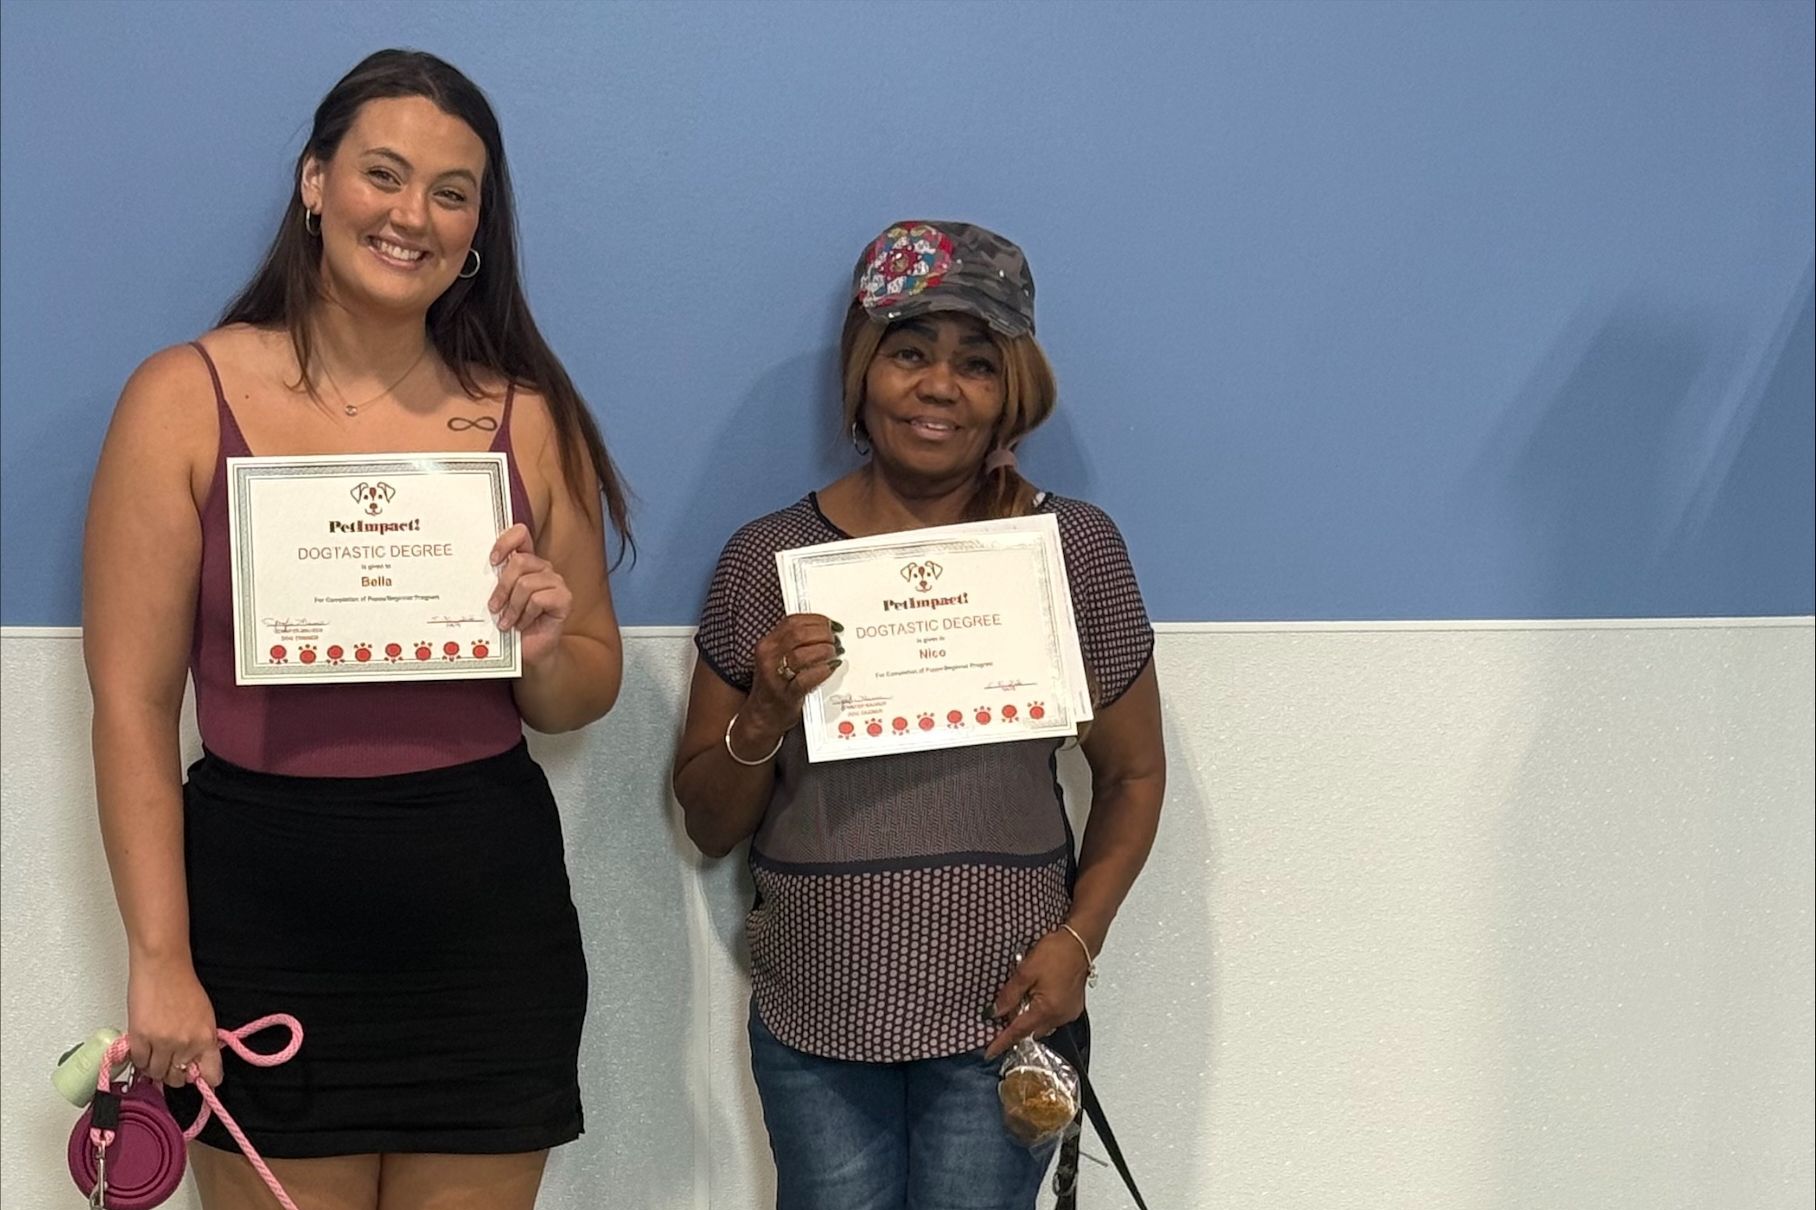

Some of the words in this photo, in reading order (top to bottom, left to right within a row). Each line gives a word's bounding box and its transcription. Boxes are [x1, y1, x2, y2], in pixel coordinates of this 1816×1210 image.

[329, 518, 420, 535] PetImpact!
[298, 545, 386, 560] DOGTASTIC
[390, 543, 454, 558] DEGREE
[361, 576, 392, 587] Bella
[883, 592, 969, 611] PetImpact!
[856, 619, 939, 639] DOGTASTIC
[942, 613, 1002, 630] DEGREE
[919, 648, 946, 659] Nico
